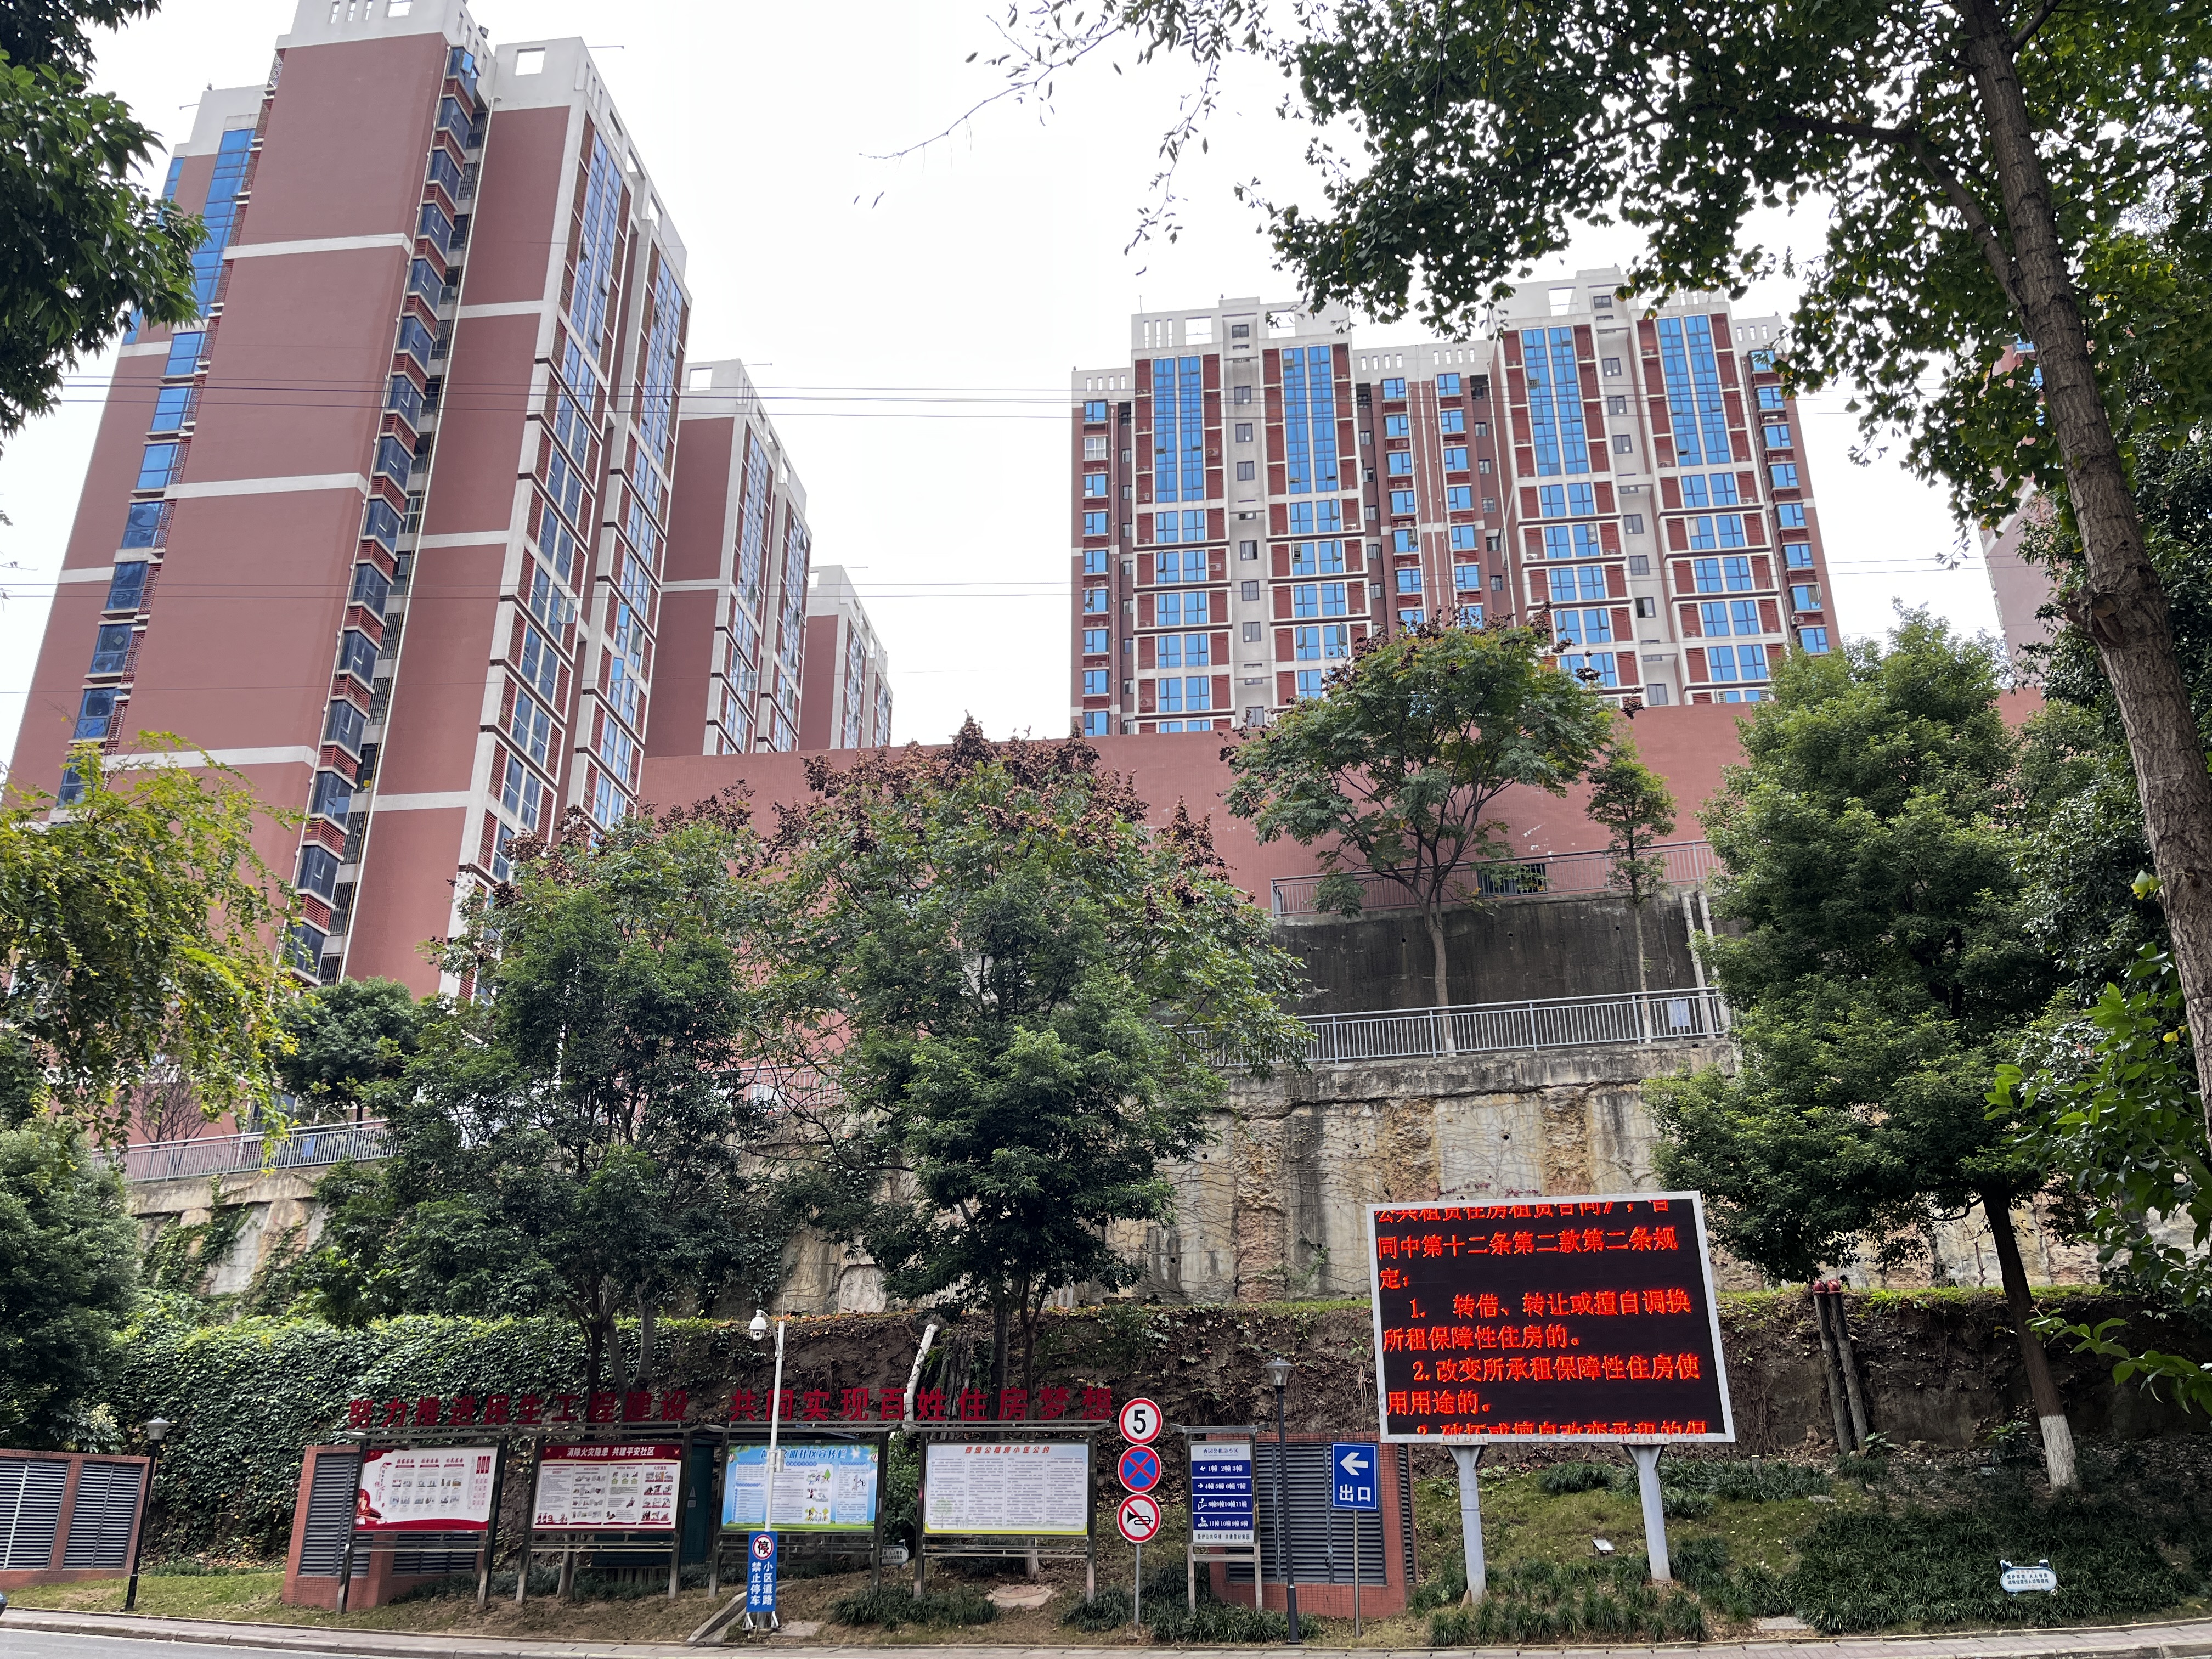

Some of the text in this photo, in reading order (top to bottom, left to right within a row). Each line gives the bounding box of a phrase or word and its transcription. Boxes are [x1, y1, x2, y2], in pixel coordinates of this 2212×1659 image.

[1378, 1226, 1679, 1260] 同中第十二条第二款第二条规
[1453, 1288, 1692, 1319] 转借、转让或擅自调换
[1383, 1323, 1579, 1352] 所租保障性住房的。
[348, 1385, 1114, 1429] 努力推进民生工程建设 共同实现百姓住房梦想
[1387, 1389, 1490, 1415] 用用途的。
[1133, 1409, 1147, 1434] 5
[567, 1446, 656, 1457] 消除火灾隐患 共建平安社区
[1339, 1484, 1372, 1503] 出口
[750, 1562, 762, 1606] 禁止停车
[762, 1561, 774, 1606] 小区道路
